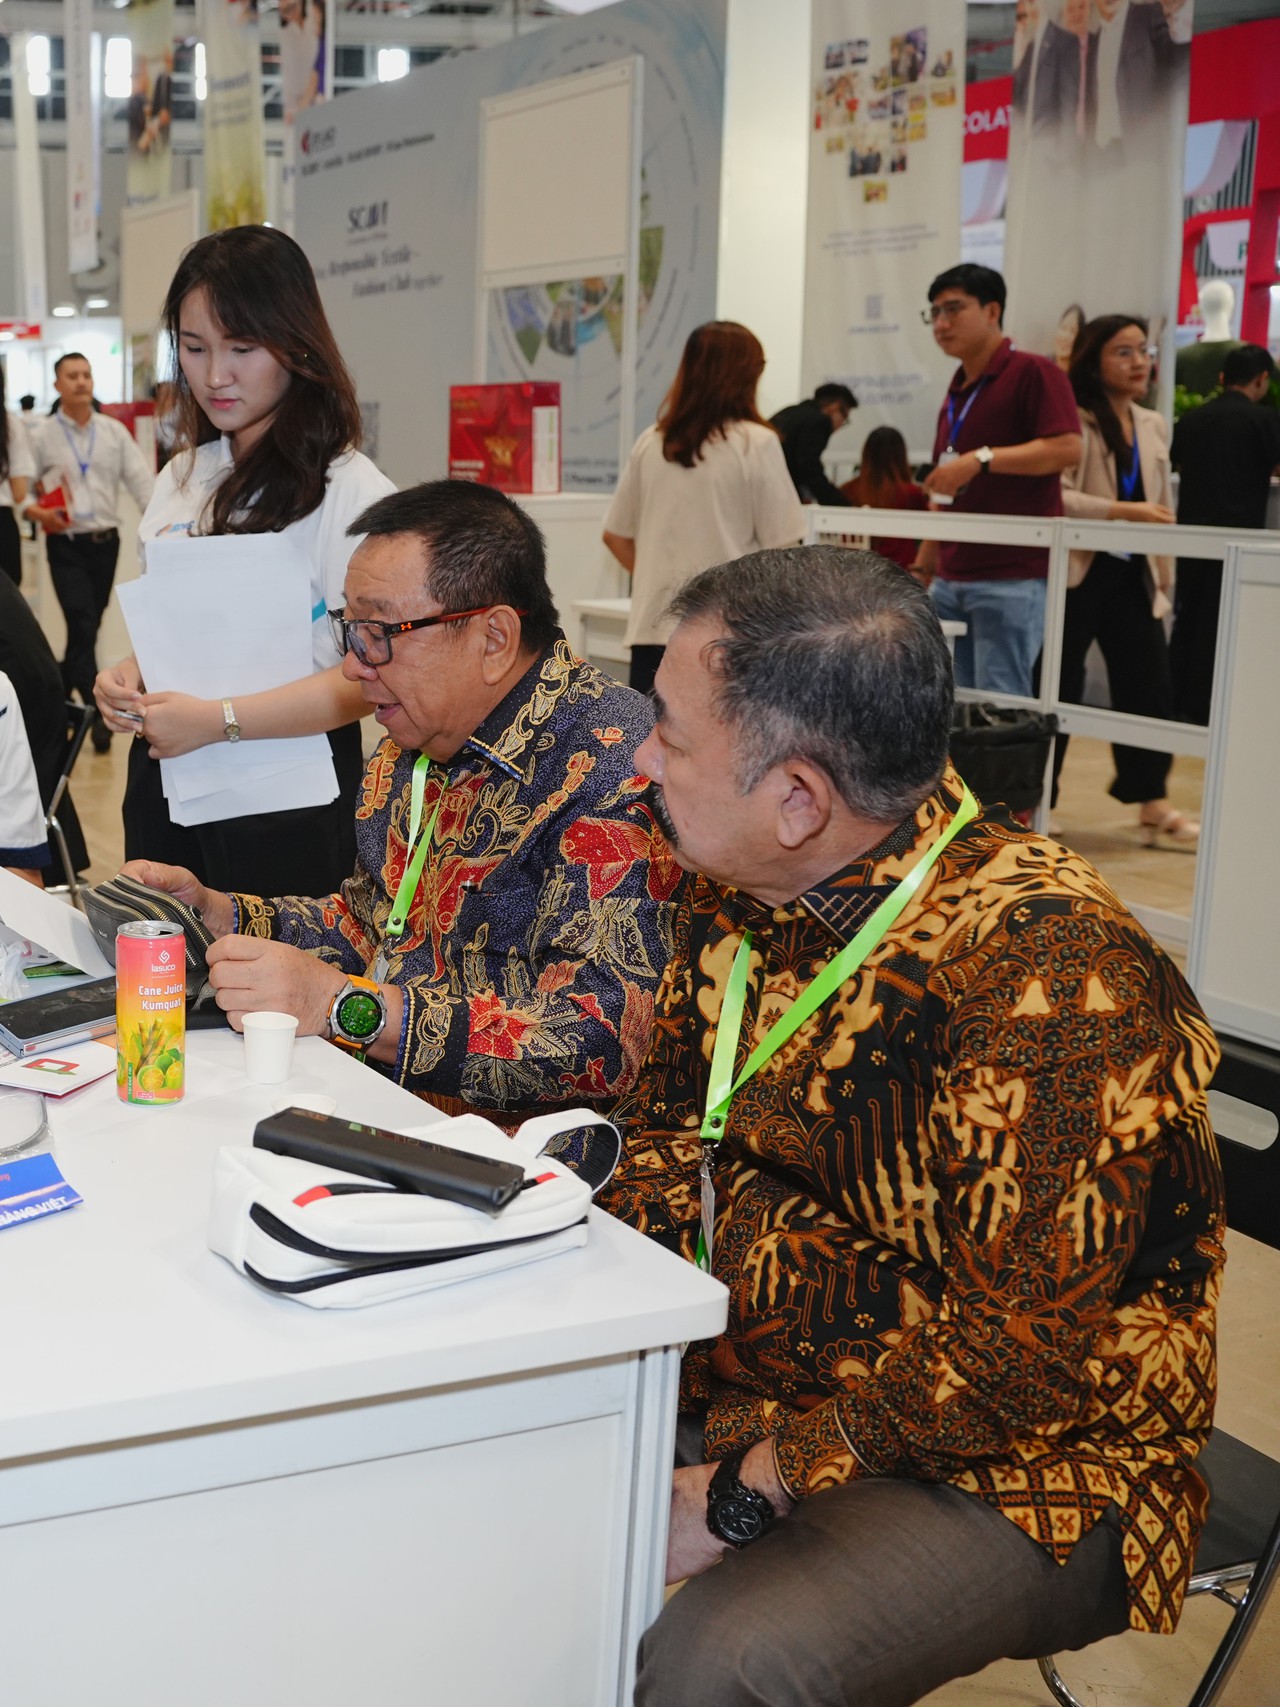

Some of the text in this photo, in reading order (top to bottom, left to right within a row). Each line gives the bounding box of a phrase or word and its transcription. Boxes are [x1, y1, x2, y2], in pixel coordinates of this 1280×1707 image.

[138, 983, 183, 996] Cane Juice
[142, 997, 182, 1012] Kumquat
